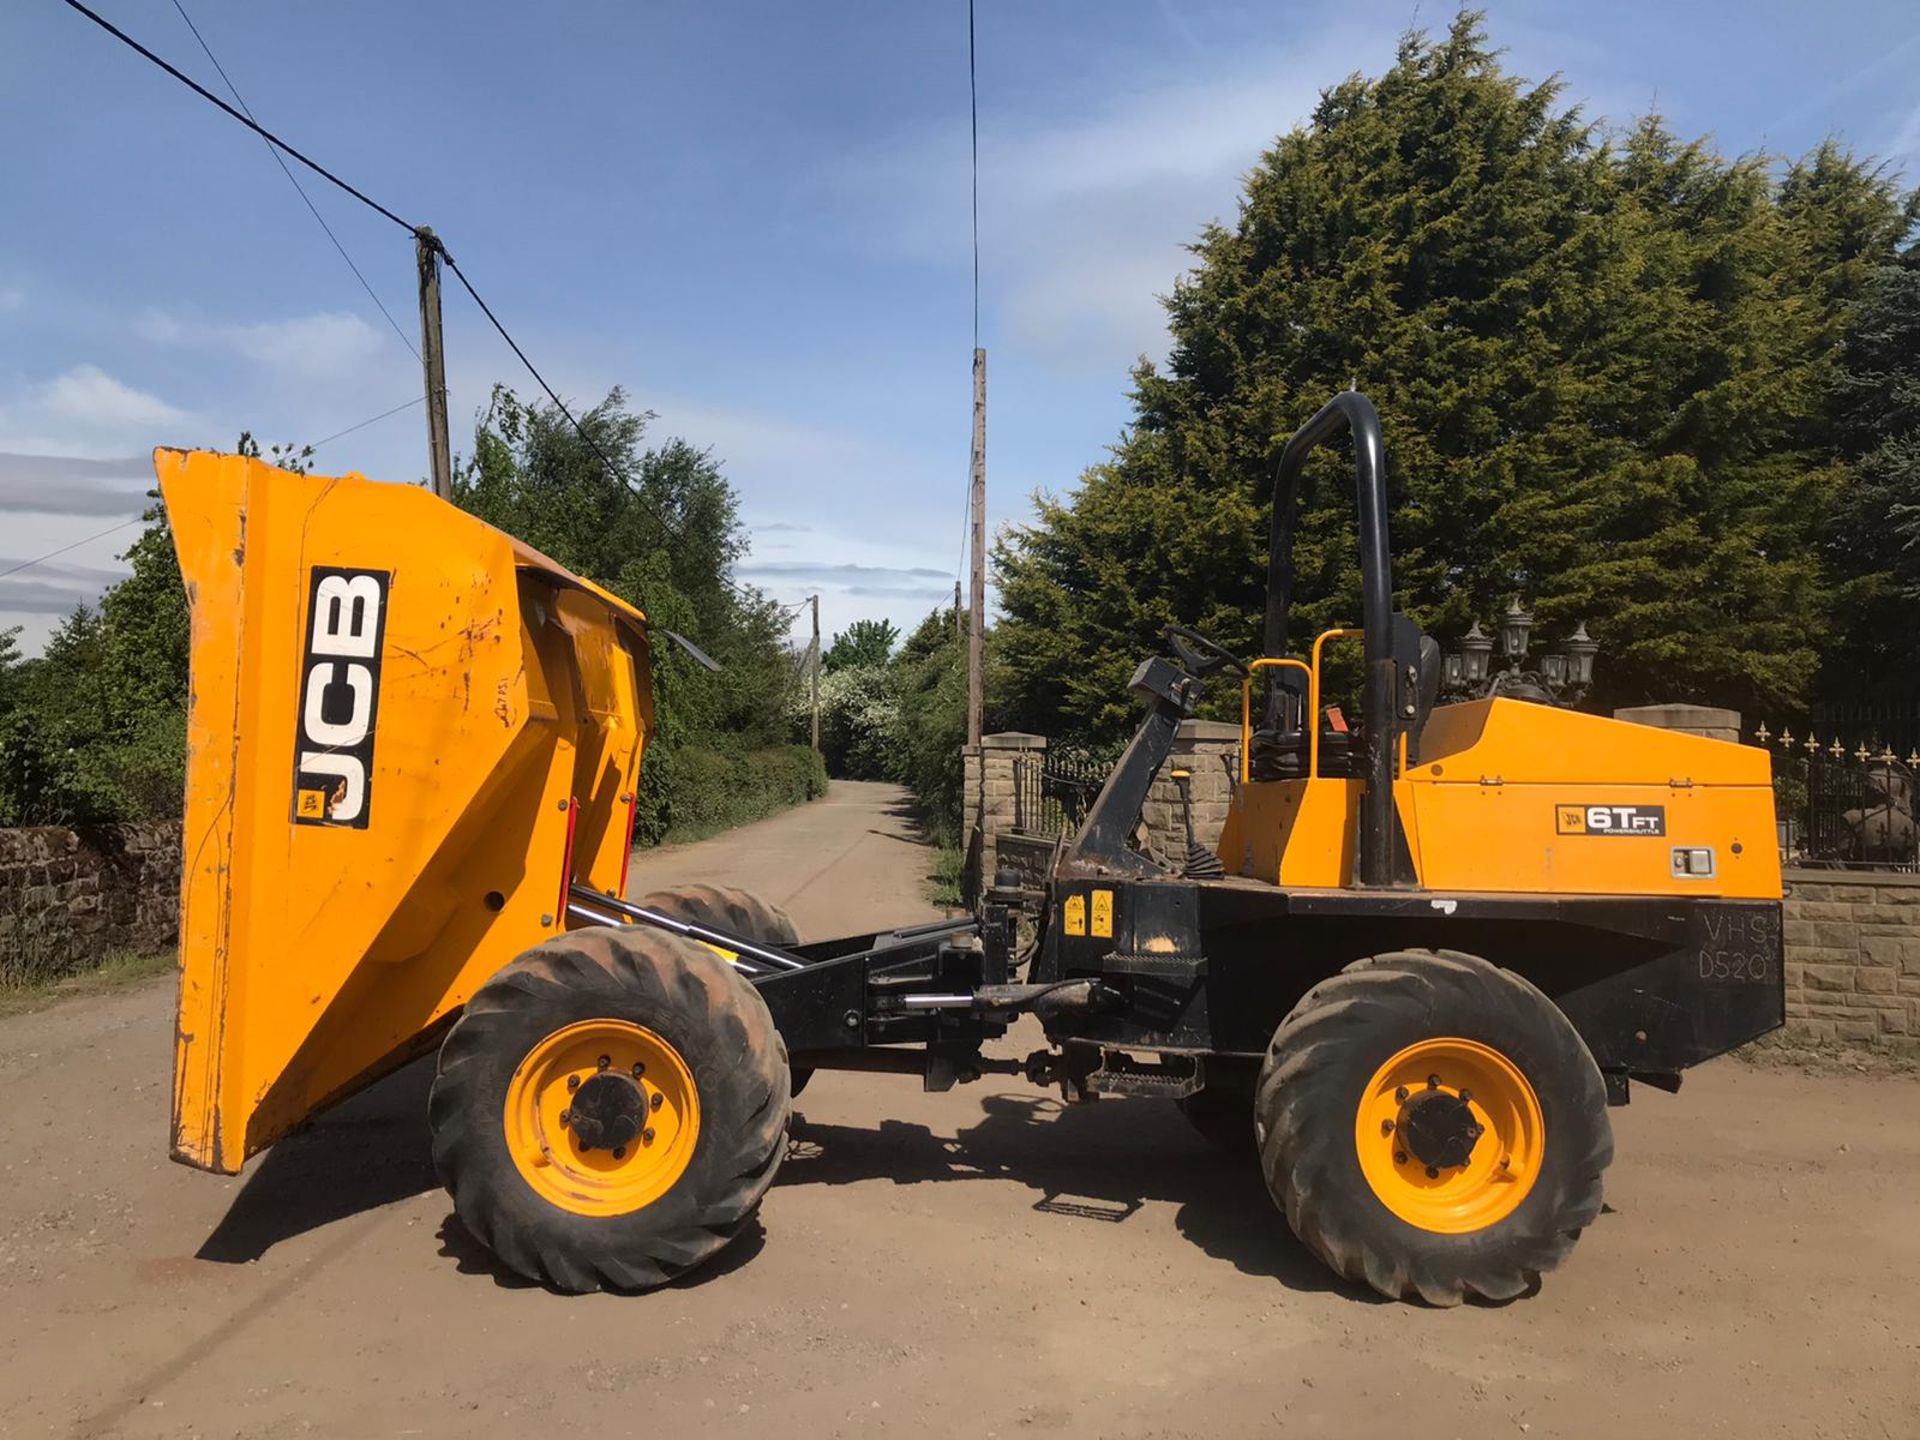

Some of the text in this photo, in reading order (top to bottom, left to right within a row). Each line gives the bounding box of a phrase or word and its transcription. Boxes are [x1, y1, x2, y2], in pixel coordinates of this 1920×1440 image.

[300, 574, 381, 821] JCB
[1703, 911, 1767, 943] VHS
[1699, 950, 1767, 979] D520
